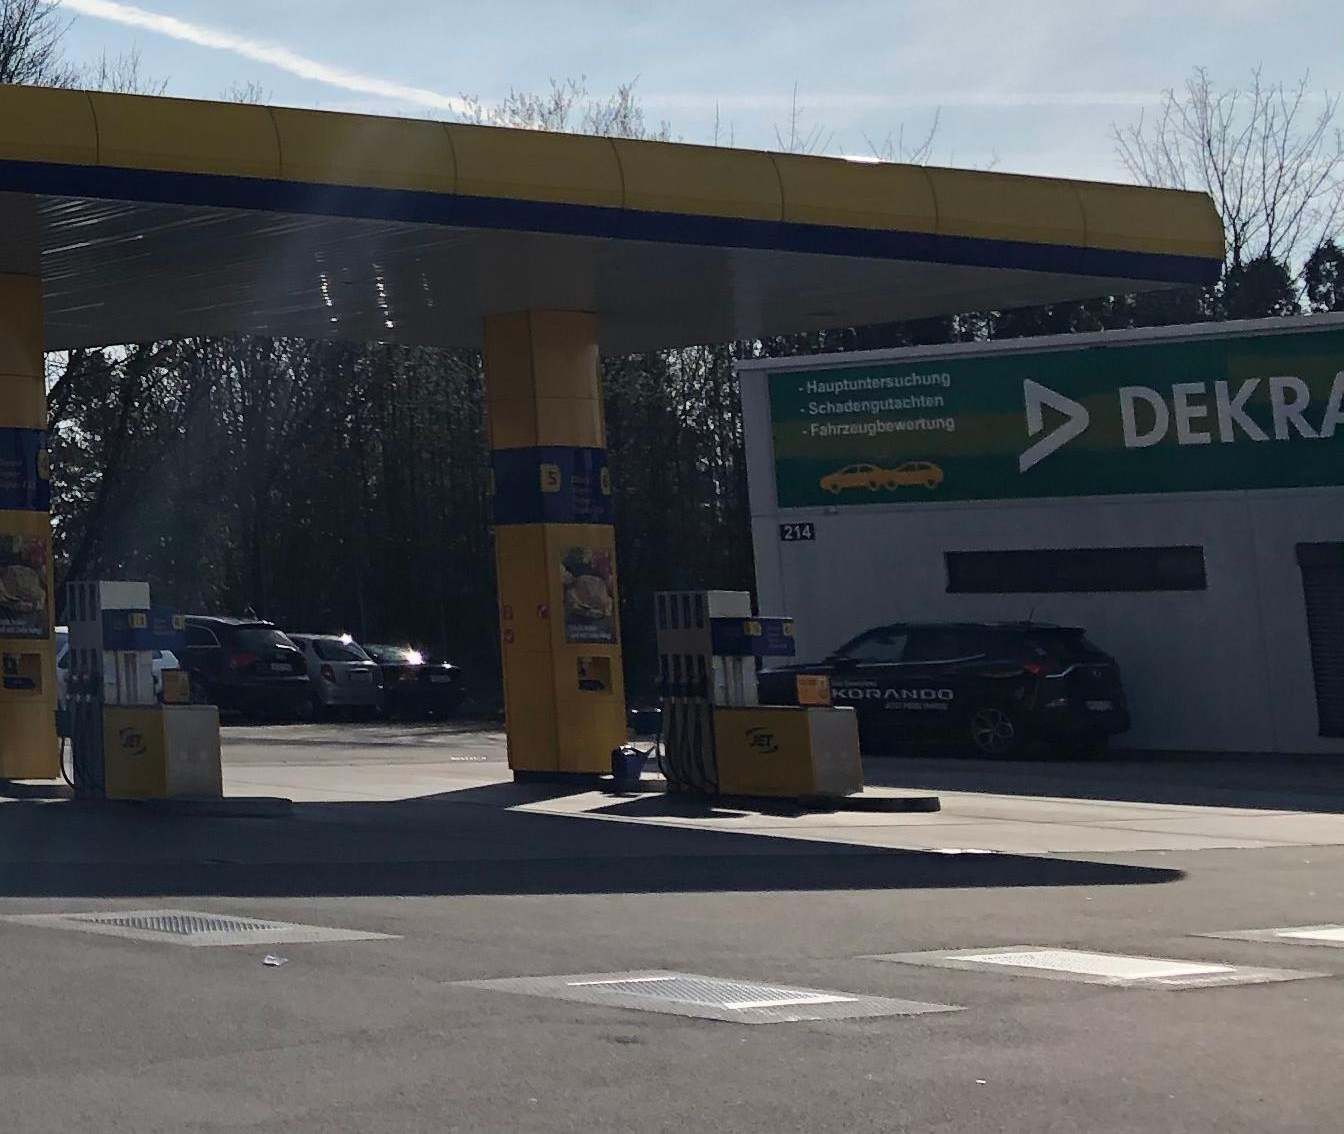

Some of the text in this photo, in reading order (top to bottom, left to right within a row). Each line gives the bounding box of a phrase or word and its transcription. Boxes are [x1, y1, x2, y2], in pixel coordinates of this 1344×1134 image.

[807, 372, 951, 394] Hauptuntersuchung
[808, 395, 944, 415] Schadengutachten
[810, 417, 955, 436] Fahrzeugbewertung
[784, 525, 812, 539] 214
[832, 688, 954, 700] KORANDO
[122, 734, 143, 748] JET
[749, 734, 774, 747] JET
